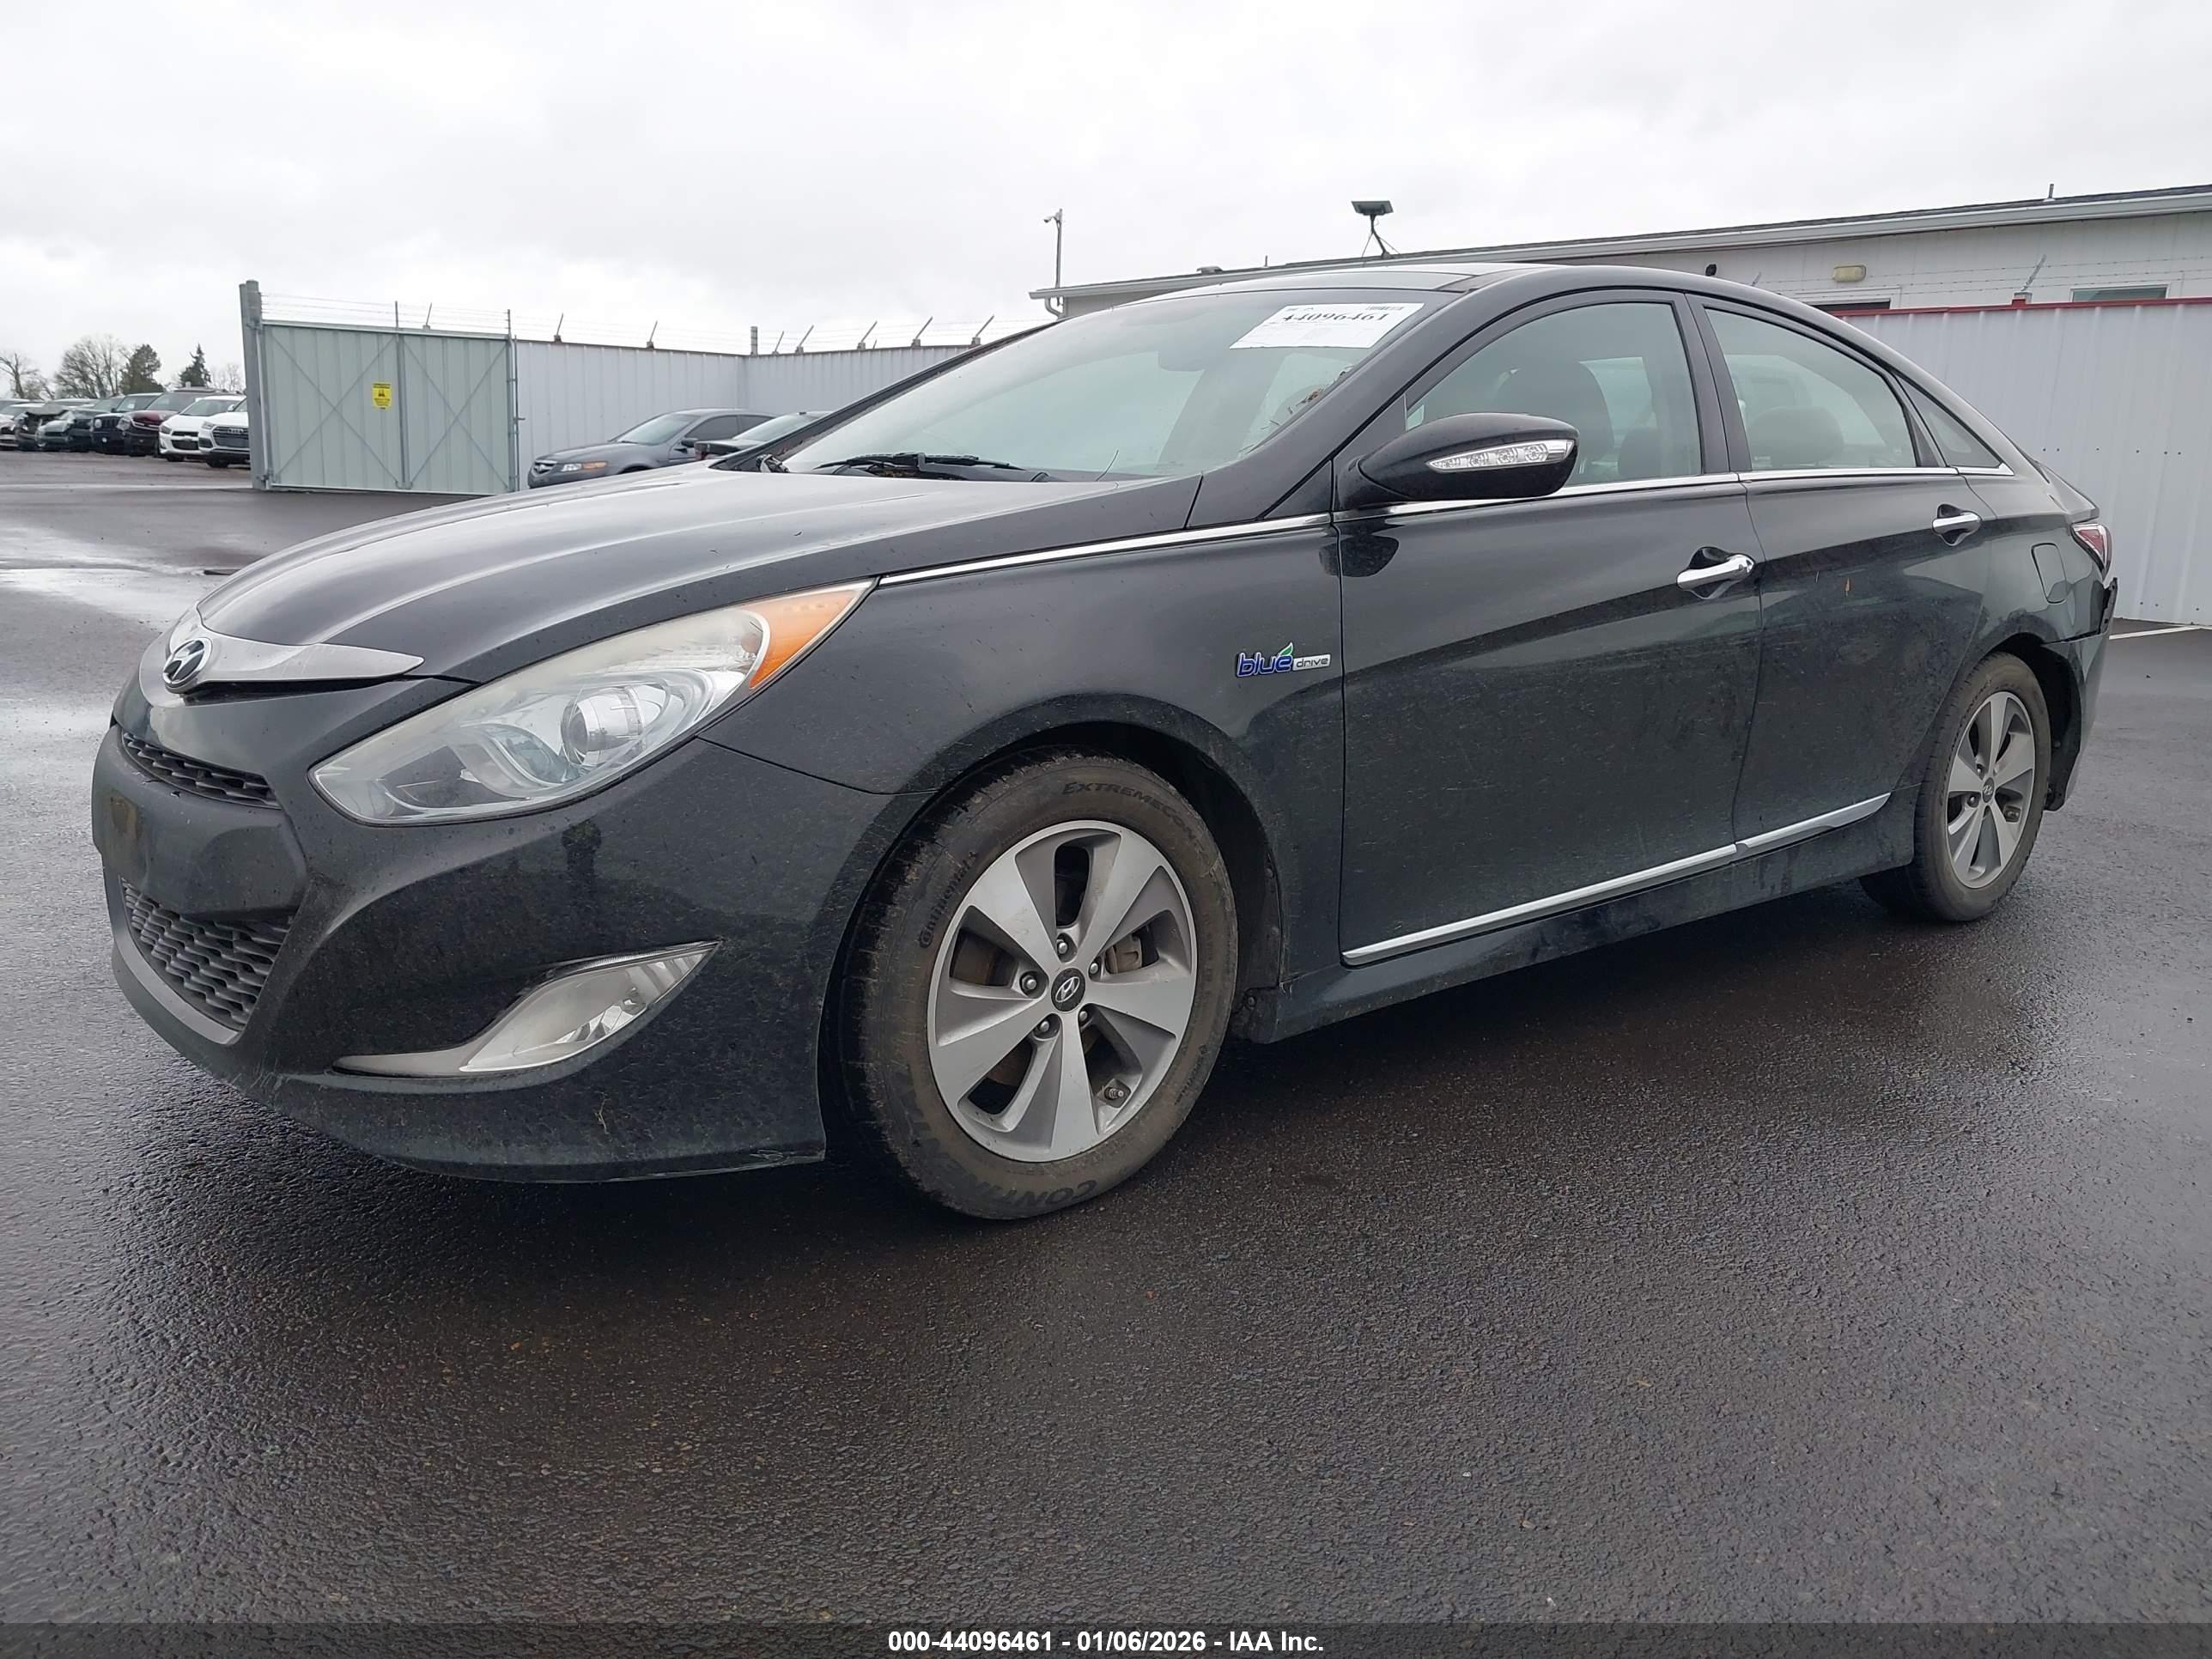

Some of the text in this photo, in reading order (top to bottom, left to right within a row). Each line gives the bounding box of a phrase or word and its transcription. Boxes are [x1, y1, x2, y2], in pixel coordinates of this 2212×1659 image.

[1283, 313, 1389, 321] 44096461
[1237, 652, 1329, 677] blue drive
